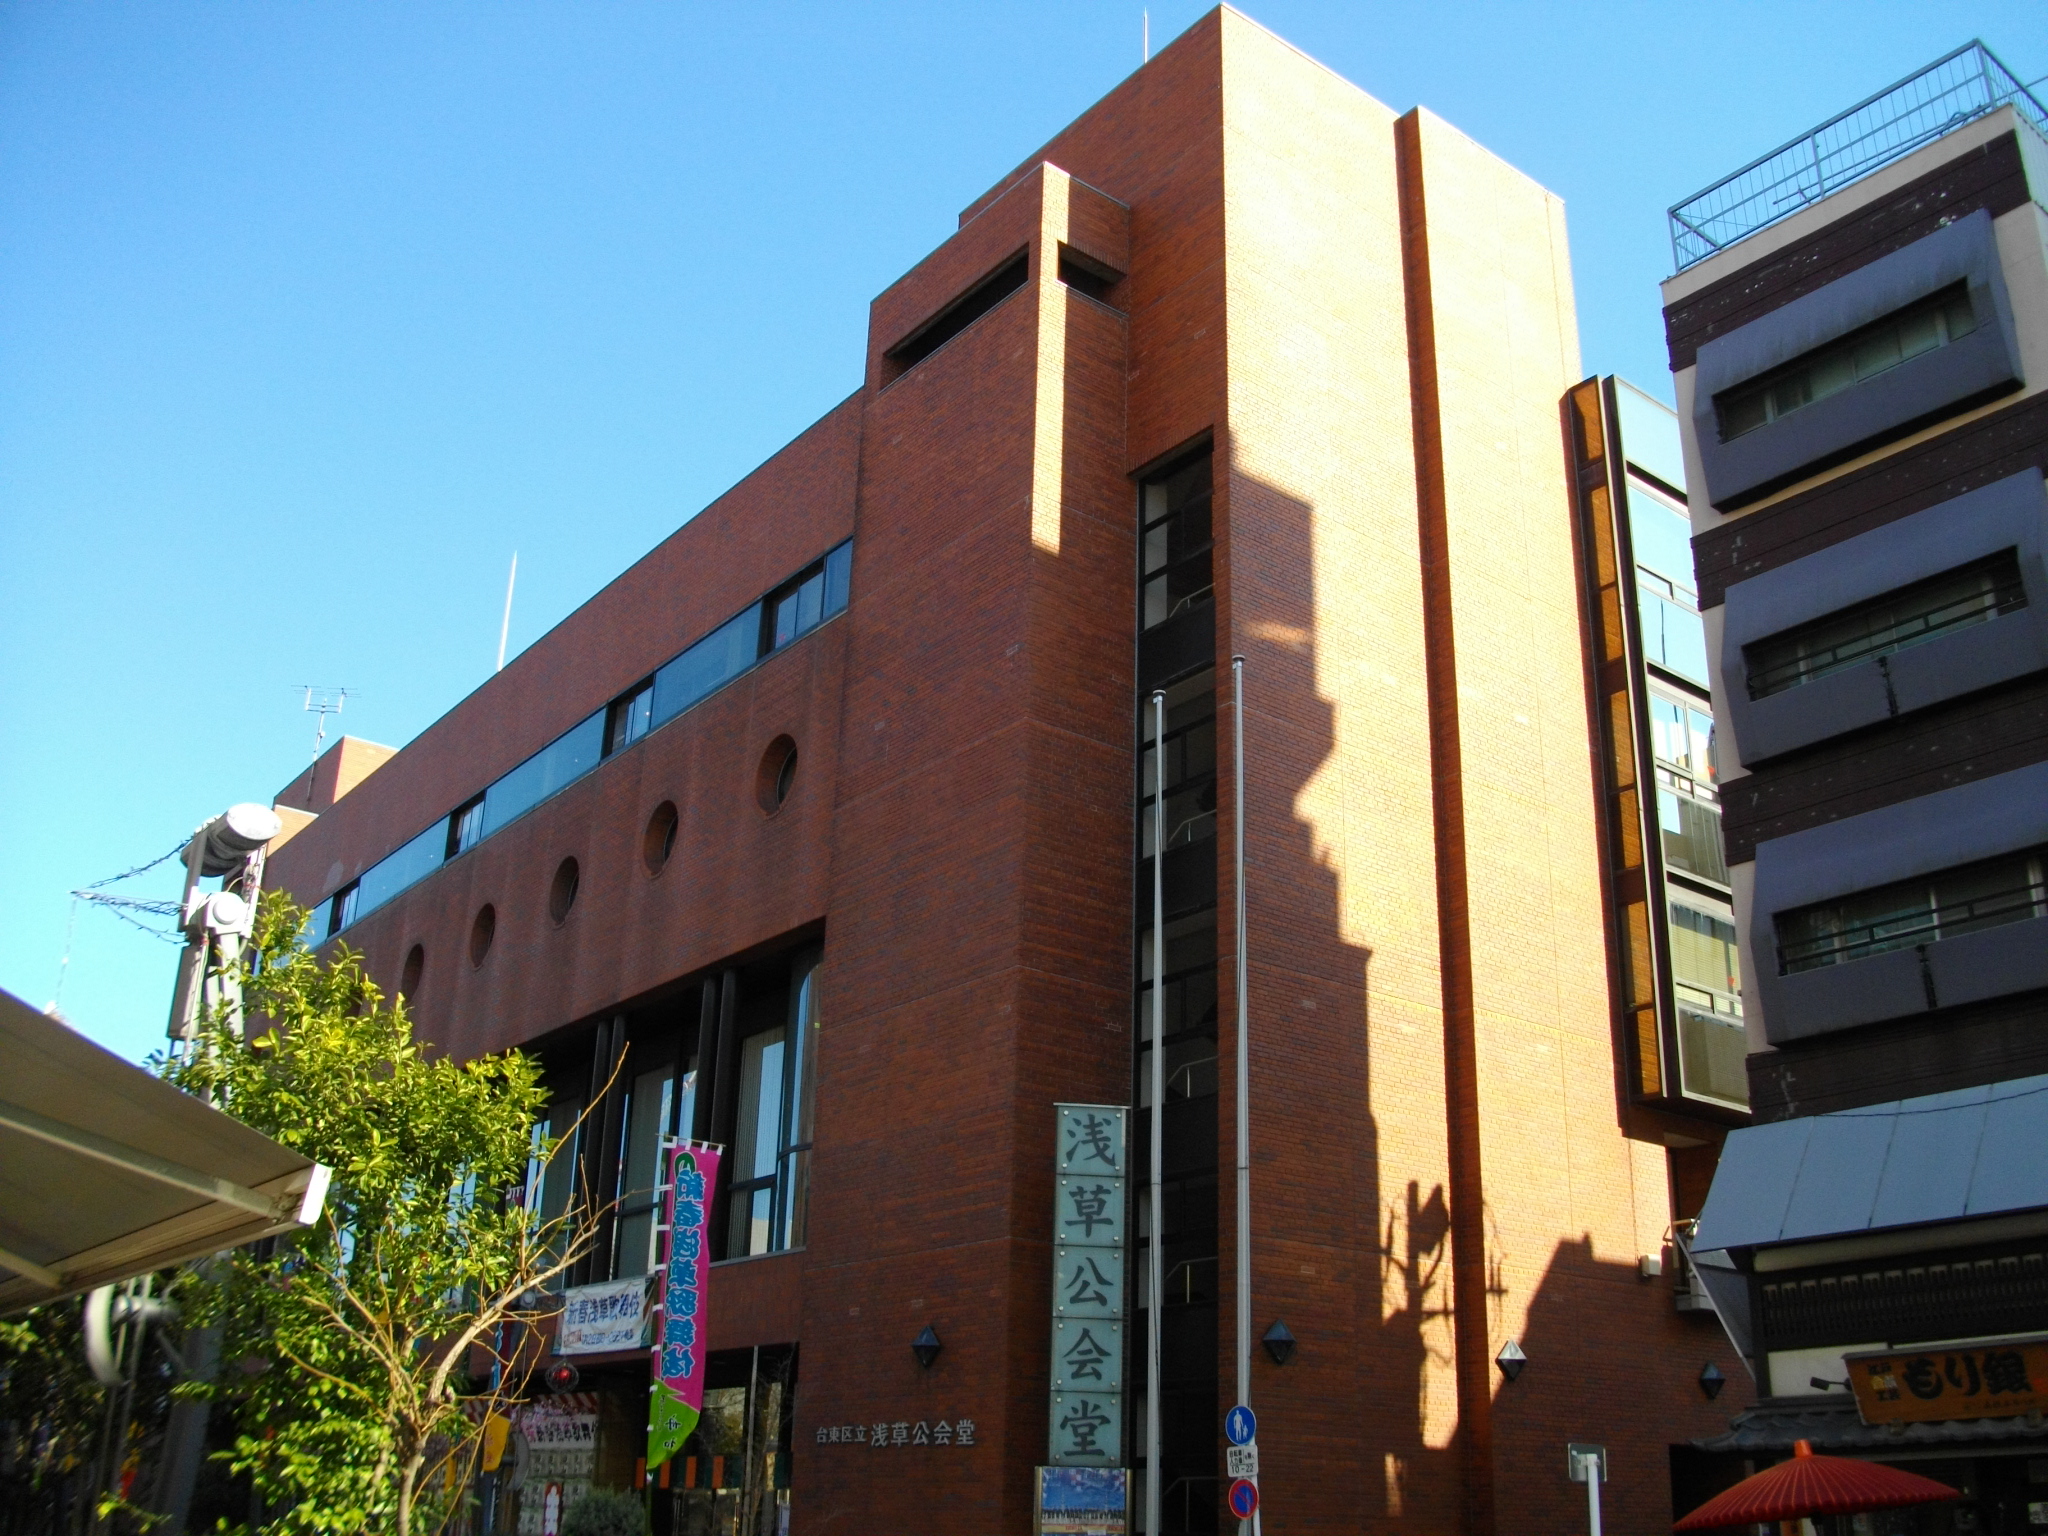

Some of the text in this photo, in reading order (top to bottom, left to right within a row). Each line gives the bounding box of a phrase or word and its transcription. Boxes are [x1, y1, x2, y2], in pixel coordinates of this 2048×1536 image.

[1060, 1113, 1117, 1457] 浅草公会堂
